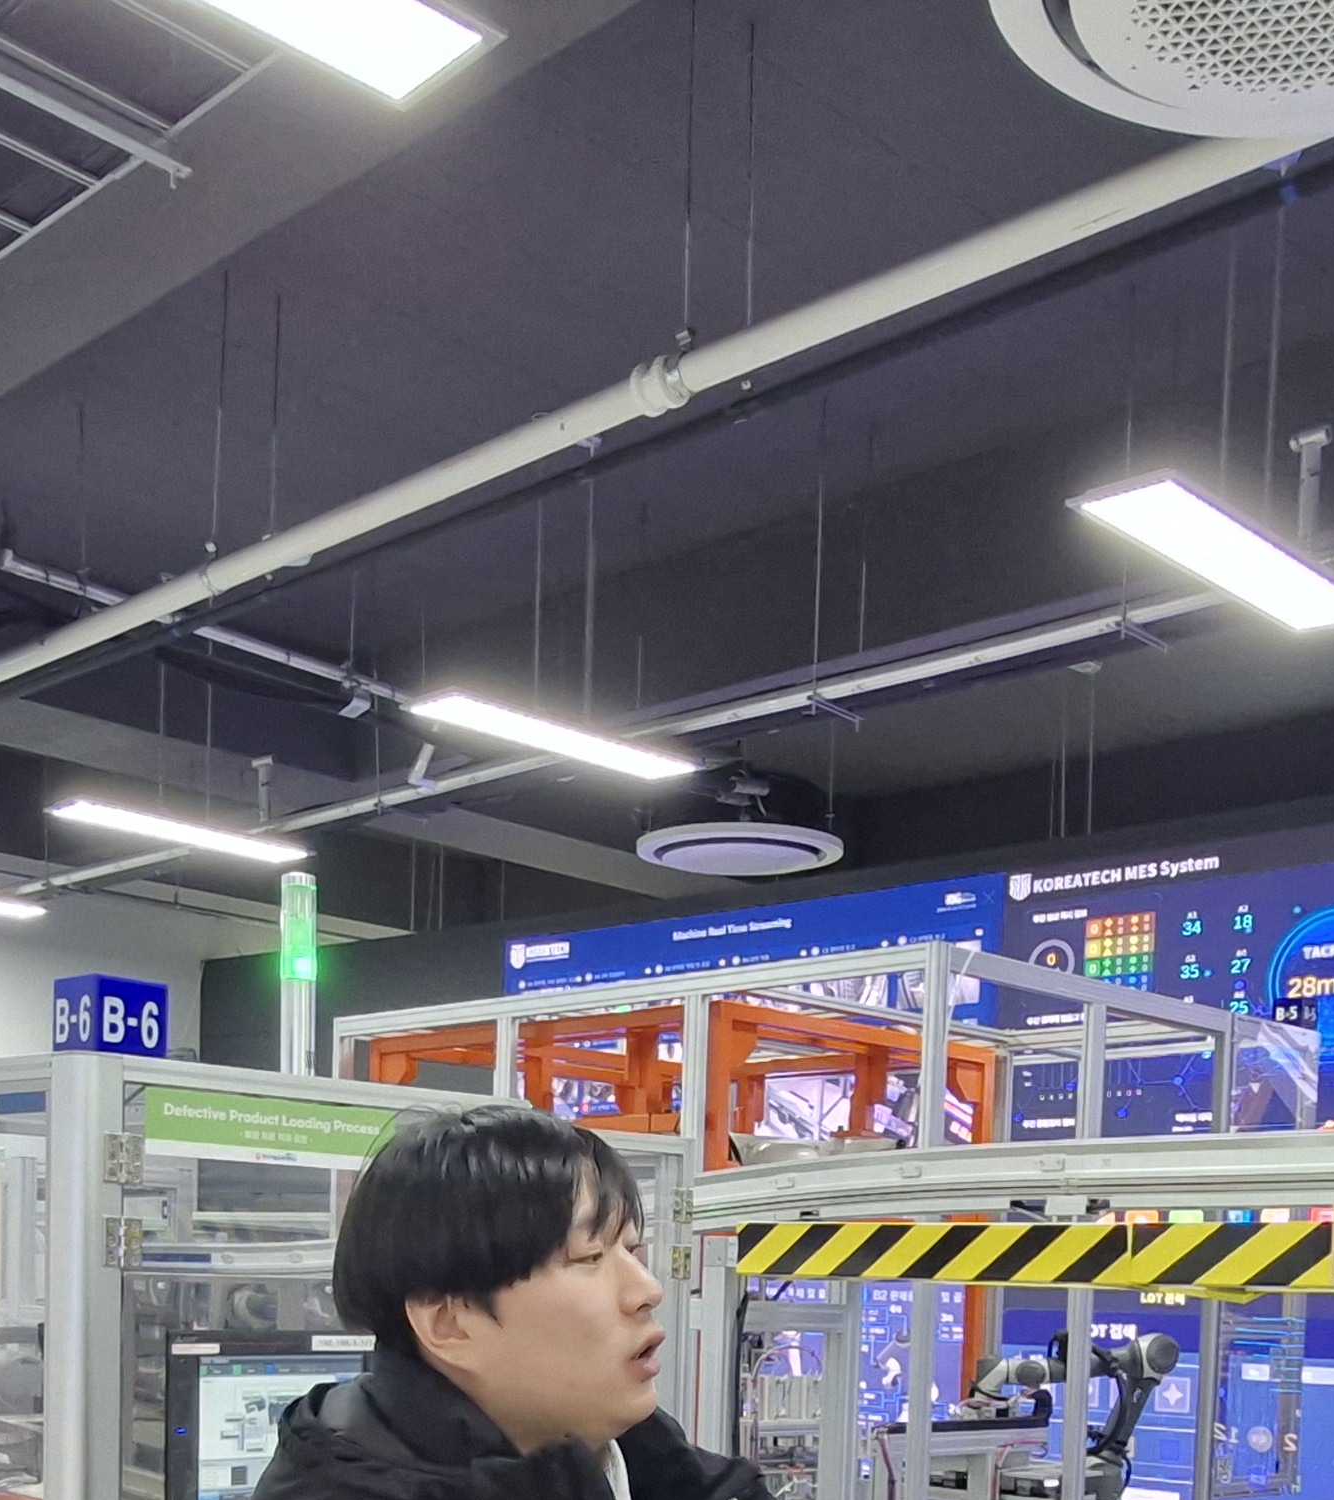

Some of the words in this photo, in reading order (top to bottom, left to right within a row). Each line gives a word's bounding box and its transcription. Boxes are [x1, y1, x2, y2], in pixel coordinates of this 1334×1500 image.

[1032, 867, 1122, 894] KOREATECH
[1124, 862, 1158, 882] MES
[1159, 855, 1221, 879] System
[1181, 920, 1202, 936] 34
[1232, 914, 1253, 930] 18
[1180, 963, 1200, 979] 35
[1230, 958, 1251, 974] 27
[55, 994, 91, 1044] B-6
[102, 995, 159, 1049] B-6
[163, 1102, 226, 1121] Defective
[229, 1109, 280, 1126] Product
[282, 1115, 332, 1134] Loading
[333, 1119, 380, 1136] Process
[1140, 1292, 1163, 1304] LOT
[1090, 1324, 1108, 1338] OT
